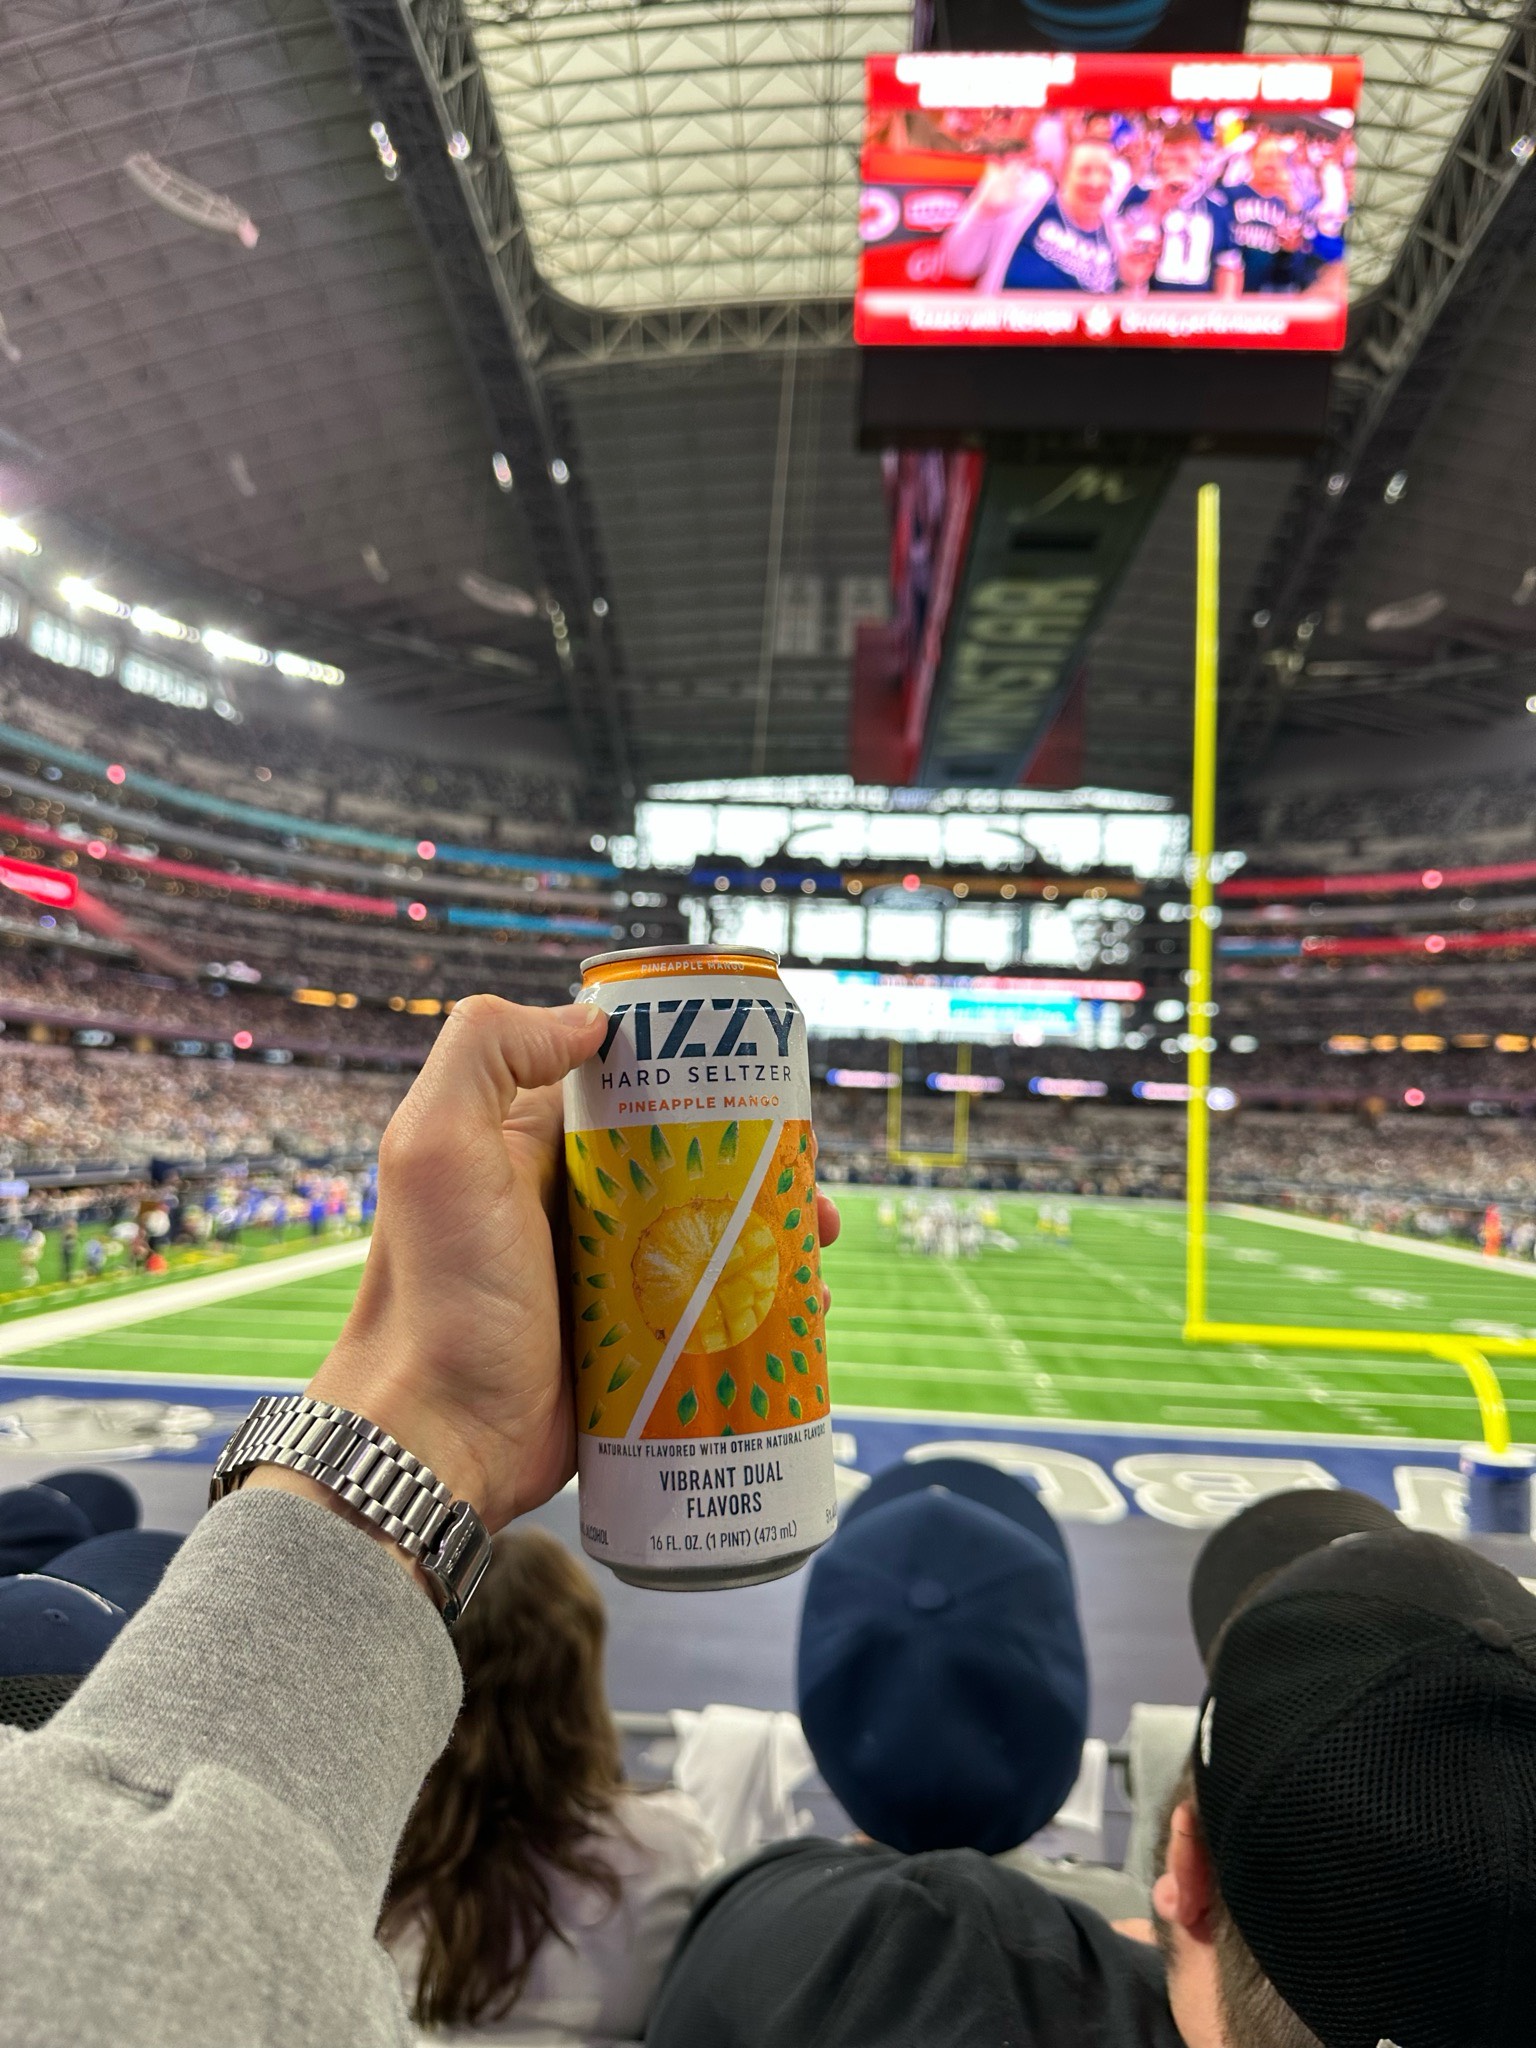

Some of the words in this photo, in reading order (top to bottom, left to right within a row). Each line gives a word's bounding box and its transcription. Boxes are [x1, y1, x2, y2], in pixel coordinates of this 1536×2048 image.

[640, 961, 703, 973] PINEAPPLE
[707, 960, 745, 972] MANGO
[601, 1068, 671, 1090] HARD
[688, 1065, 792, 1083] SELTZER
[618, 1096, 716, 1114] PINEAPPLE
[723, 1095, 780, 1108] MANGO
[598, 1442, 642, 1458] NATURALLY
[646, 1444, 696, 1458] FLAVORED
[700, 1441, 727, 1456] WITH
[730, 1438, 763, 1454] OTHER
[766, 1431, 803, 1449] NATURAL
[804, 1423, 826, 1441] FLAVORS
[659, 1467, 737, 1492] VIBRANT
[743, 1460, 784, 1487] DUAL
[687, 1491, 762, 1519] FLAVORS
[650, 1534, 663, 1551] 16
[666, 1535, 681, 1551] FL.
[685, 1533, 703, 1550] OZ.
[706, 1532, 717, 1551] (1
[720, 1529, 751, 1548] PINT)
[754, 1526, 777, 1545] (473
[780, 1519, 797, 1541] mL)
